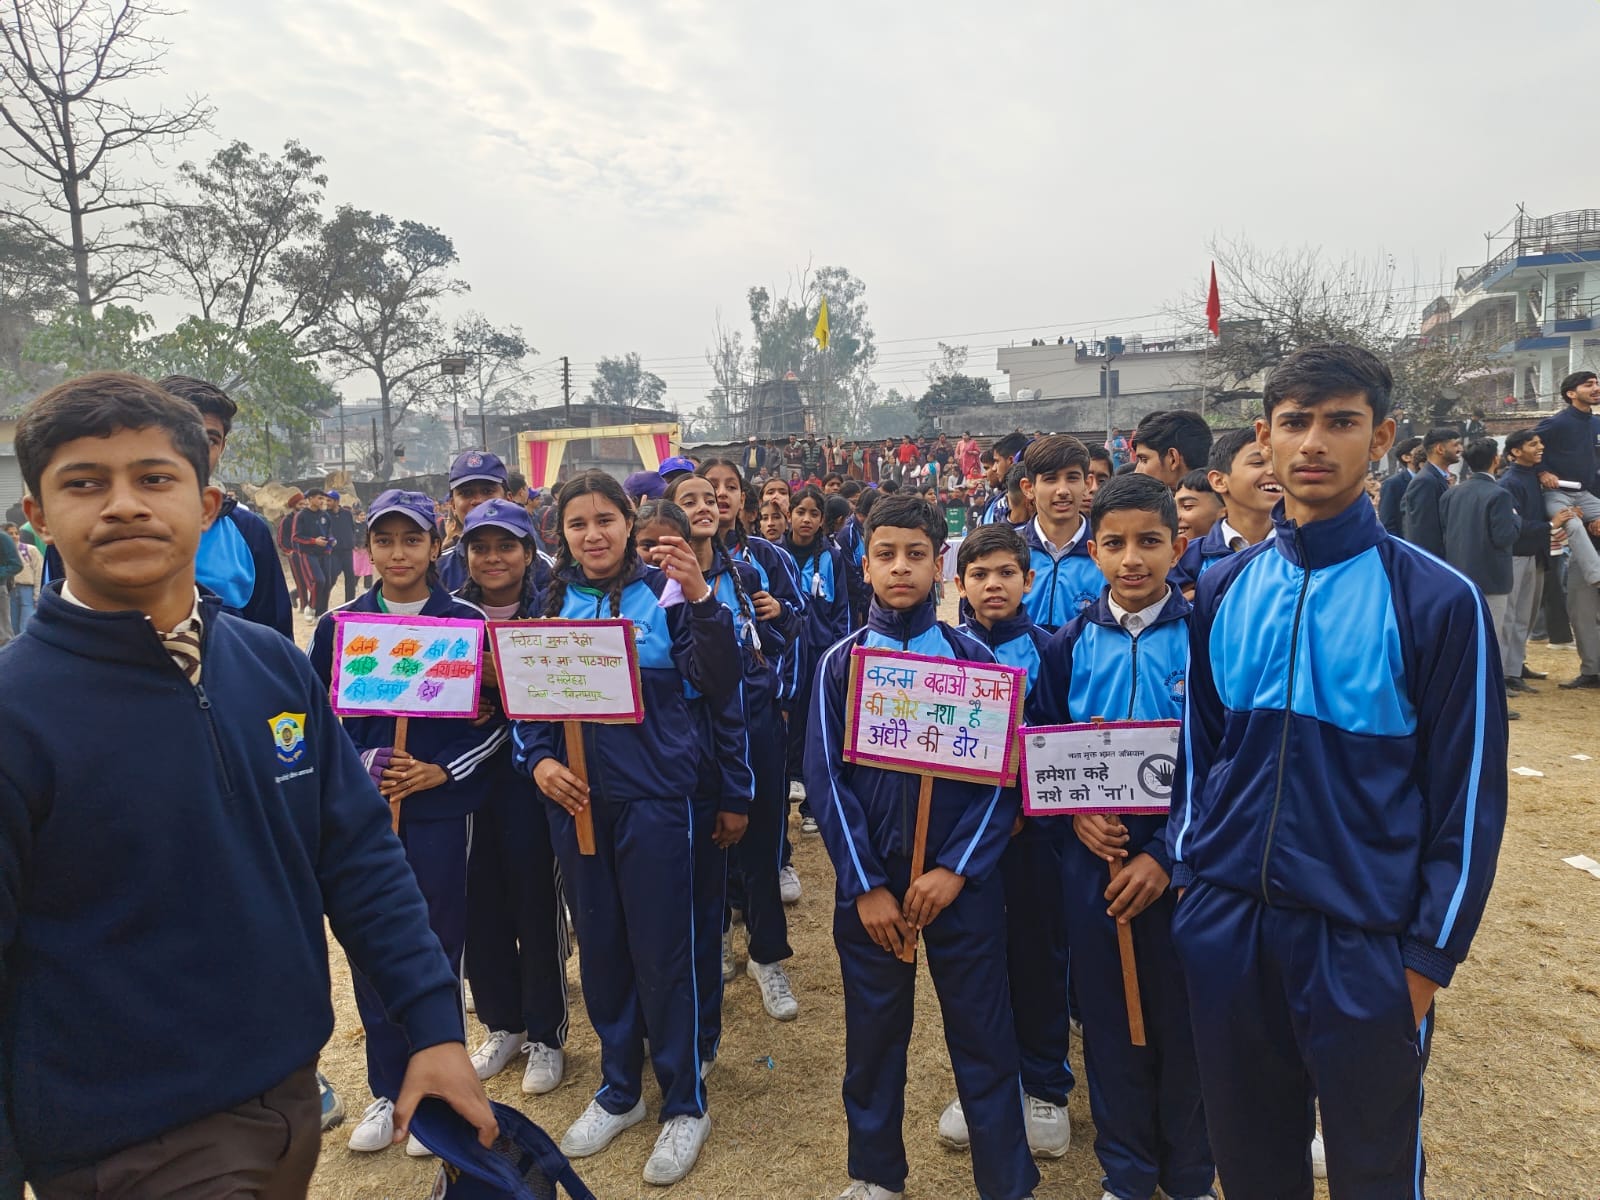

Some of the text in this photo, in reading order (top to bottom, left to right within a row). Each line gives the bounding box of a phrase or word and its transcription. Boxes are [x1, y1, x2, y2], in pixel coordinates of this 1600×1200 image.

[569, 631, 595, 648] रैली
[577, 655, 623, 668] पाठशाला
[867, 665, 917, 690] कदम
[421, 680, 441, 698] देश
[865, 689, 983, 729] की ओर नशा है
[867, 718, 912, 750] अंधेरे
[917, 725, 945, 754] की
[1034, 761, 1110, 785] हमेशा कहे
[1036, 785, 1063, 804] नशे
[1068, 783, 1091, 803] को
